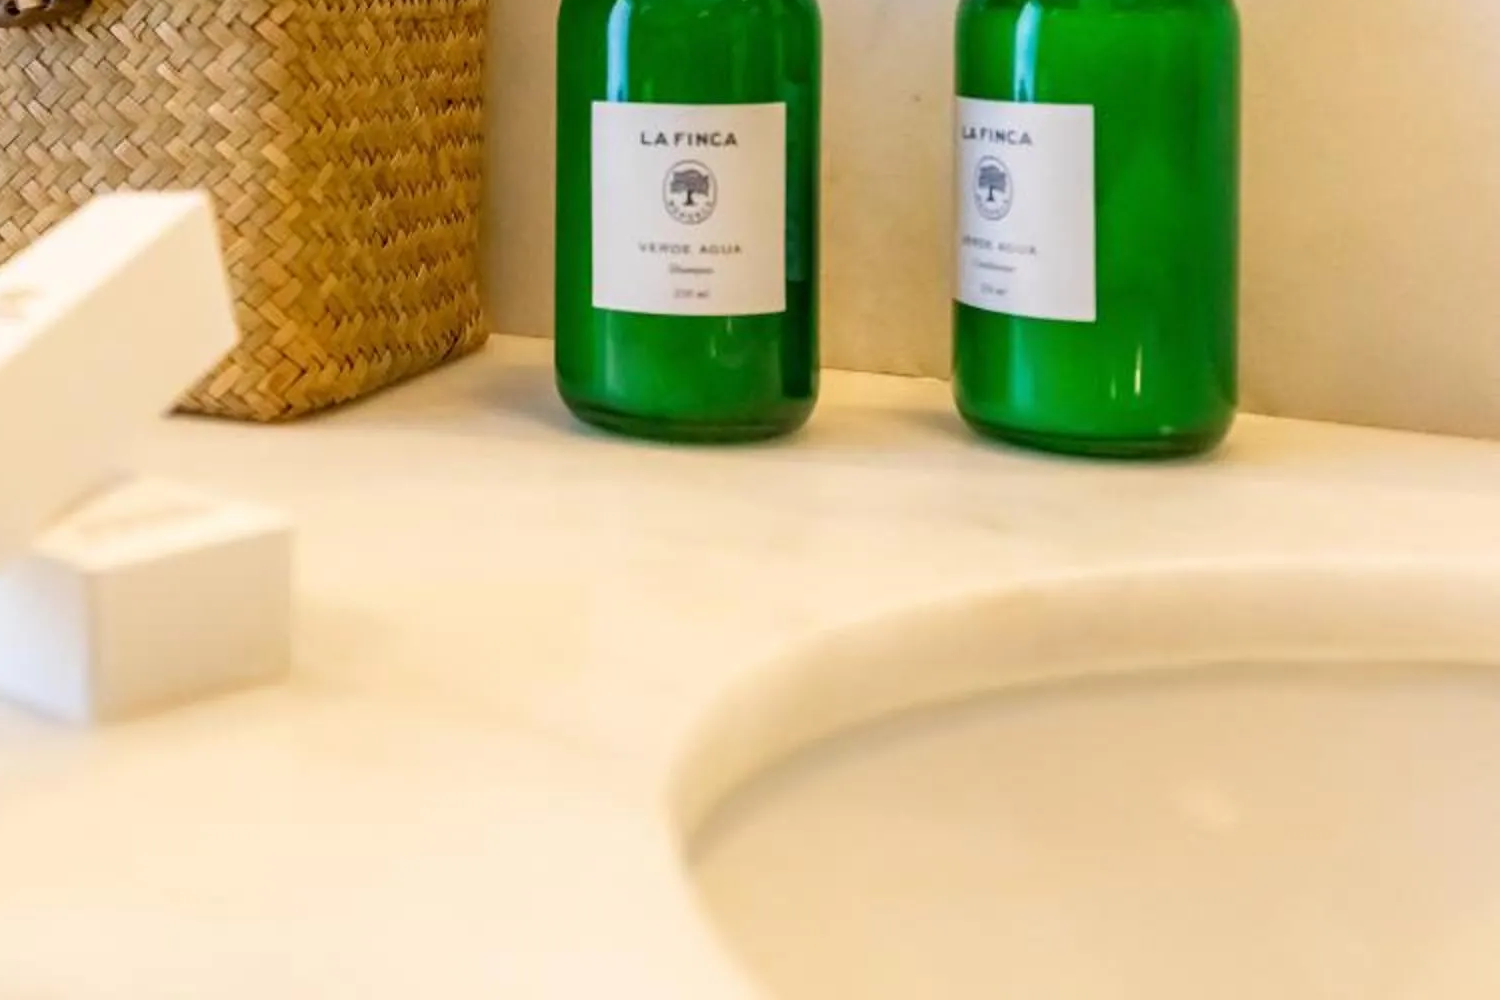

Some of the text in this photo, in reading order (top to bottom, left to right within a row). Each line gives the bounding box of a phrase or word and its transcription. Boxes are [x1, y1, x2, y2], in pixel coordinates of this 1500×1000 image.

[640, 131, 738, 146] LA FINCA
[980, 126, 1033, 146] FINCA
